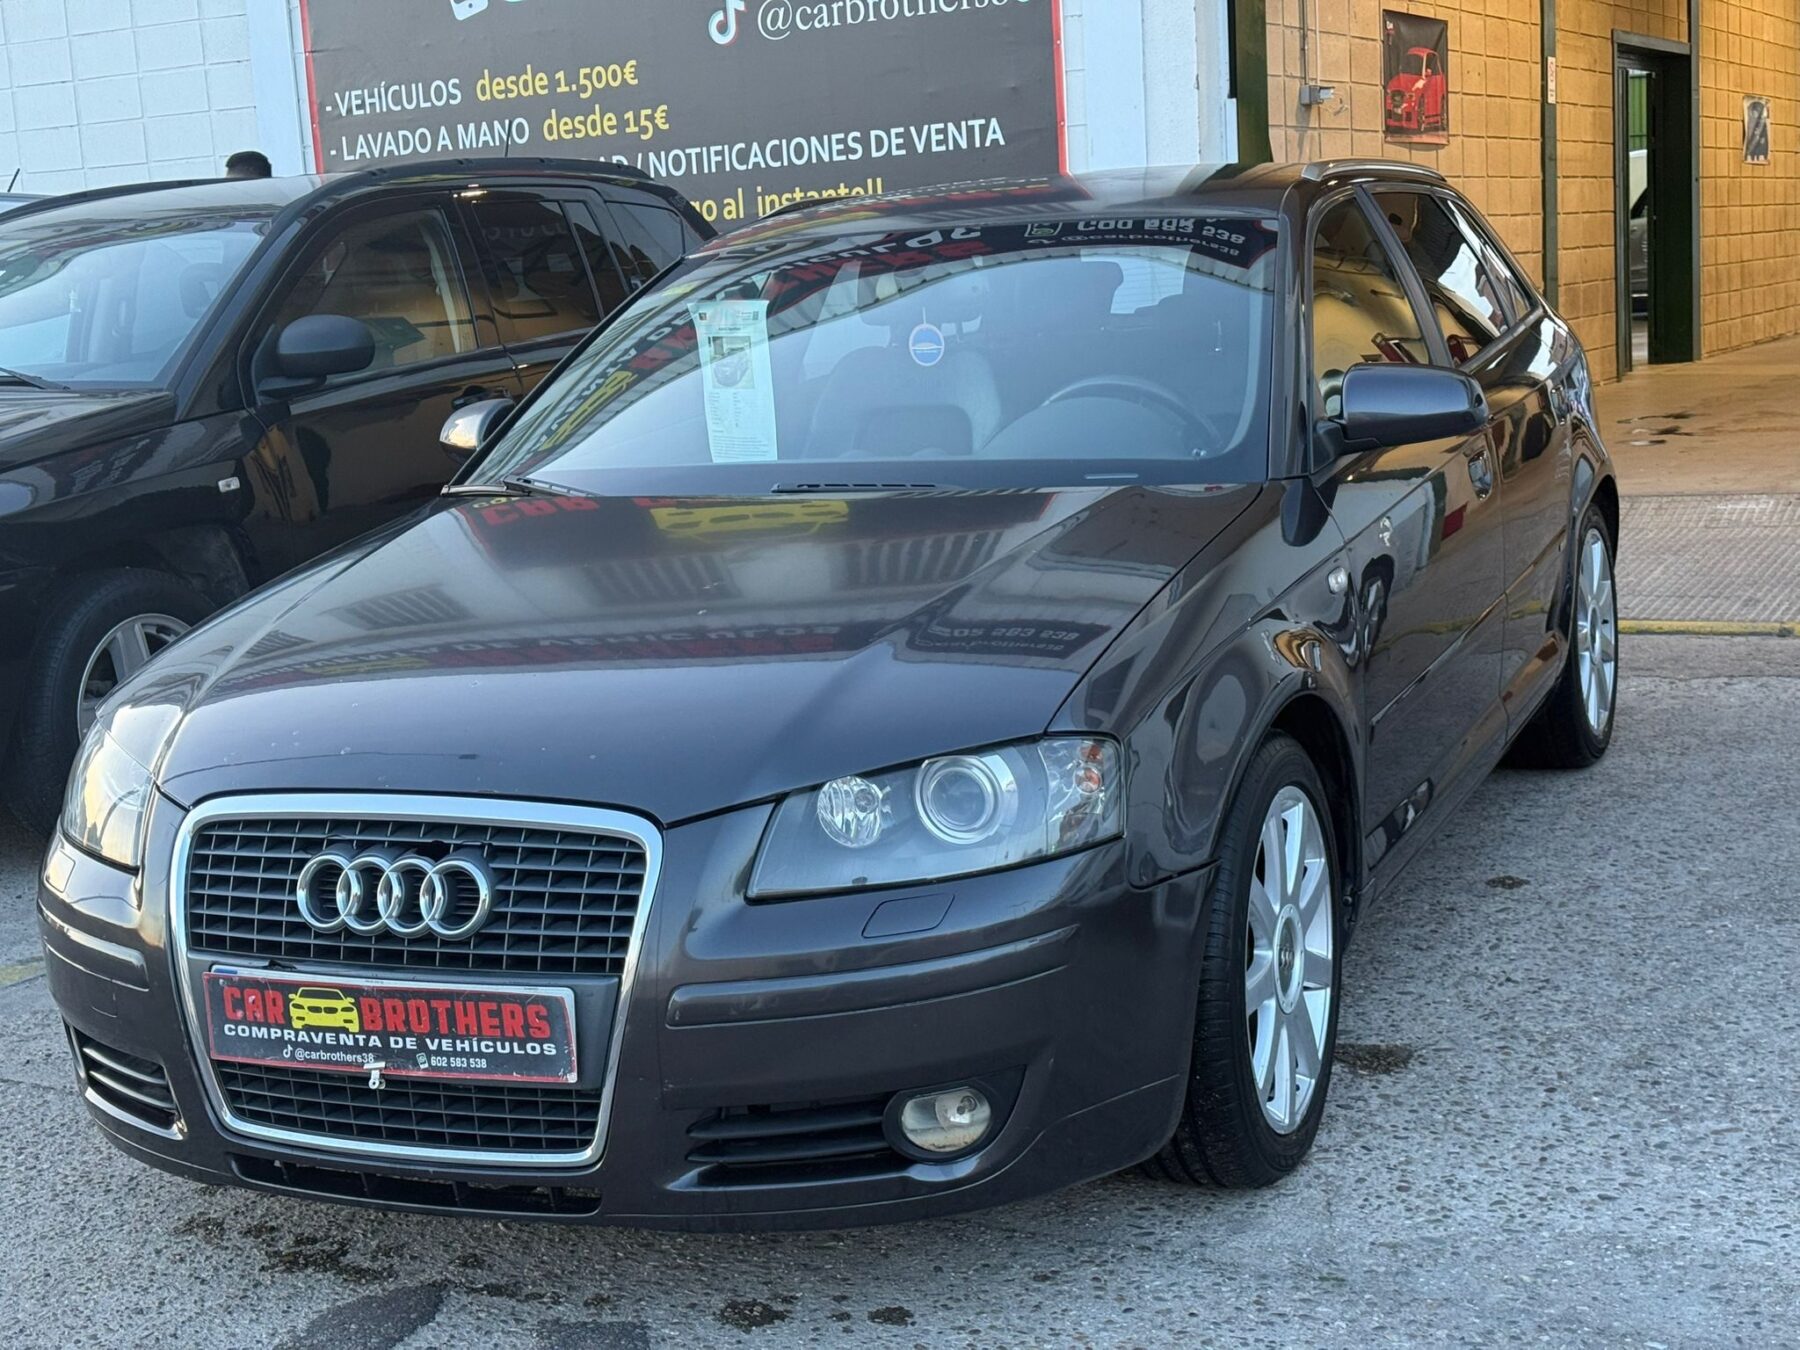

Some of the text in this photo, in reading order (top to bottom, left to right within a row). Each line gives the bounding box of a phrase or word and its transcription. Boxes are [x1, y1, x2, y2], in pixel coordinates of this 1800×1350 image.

[757, 0, 1030, 40] @carbrot
[475, 64, 549, 102] desde
[554, 60, 639, 98] 1.500€
[342, 127, 432, 161] LAVADO
[437, 125, 453, 152] A
[457, 117, 530, 150] MANO
[542, 104, 618, 142] desde
[624, 105, 670, 140] 15€
[648, 132, 863, 178] NOTIFICACIONES
[870, 127, 906, 158] DE
[909, 117, 1006, 155] VENTA
[723, 187, 745, 220] al
[223, 986, 551, 1039] CAR BROTHERS
[224, 1023, 557, 1056] COMPRAVENTA DE VEHÍCULOS
[294, 1048, 375, 1064] @carbrothers38
[430, 1055, 487, 1069] 602 583 538
